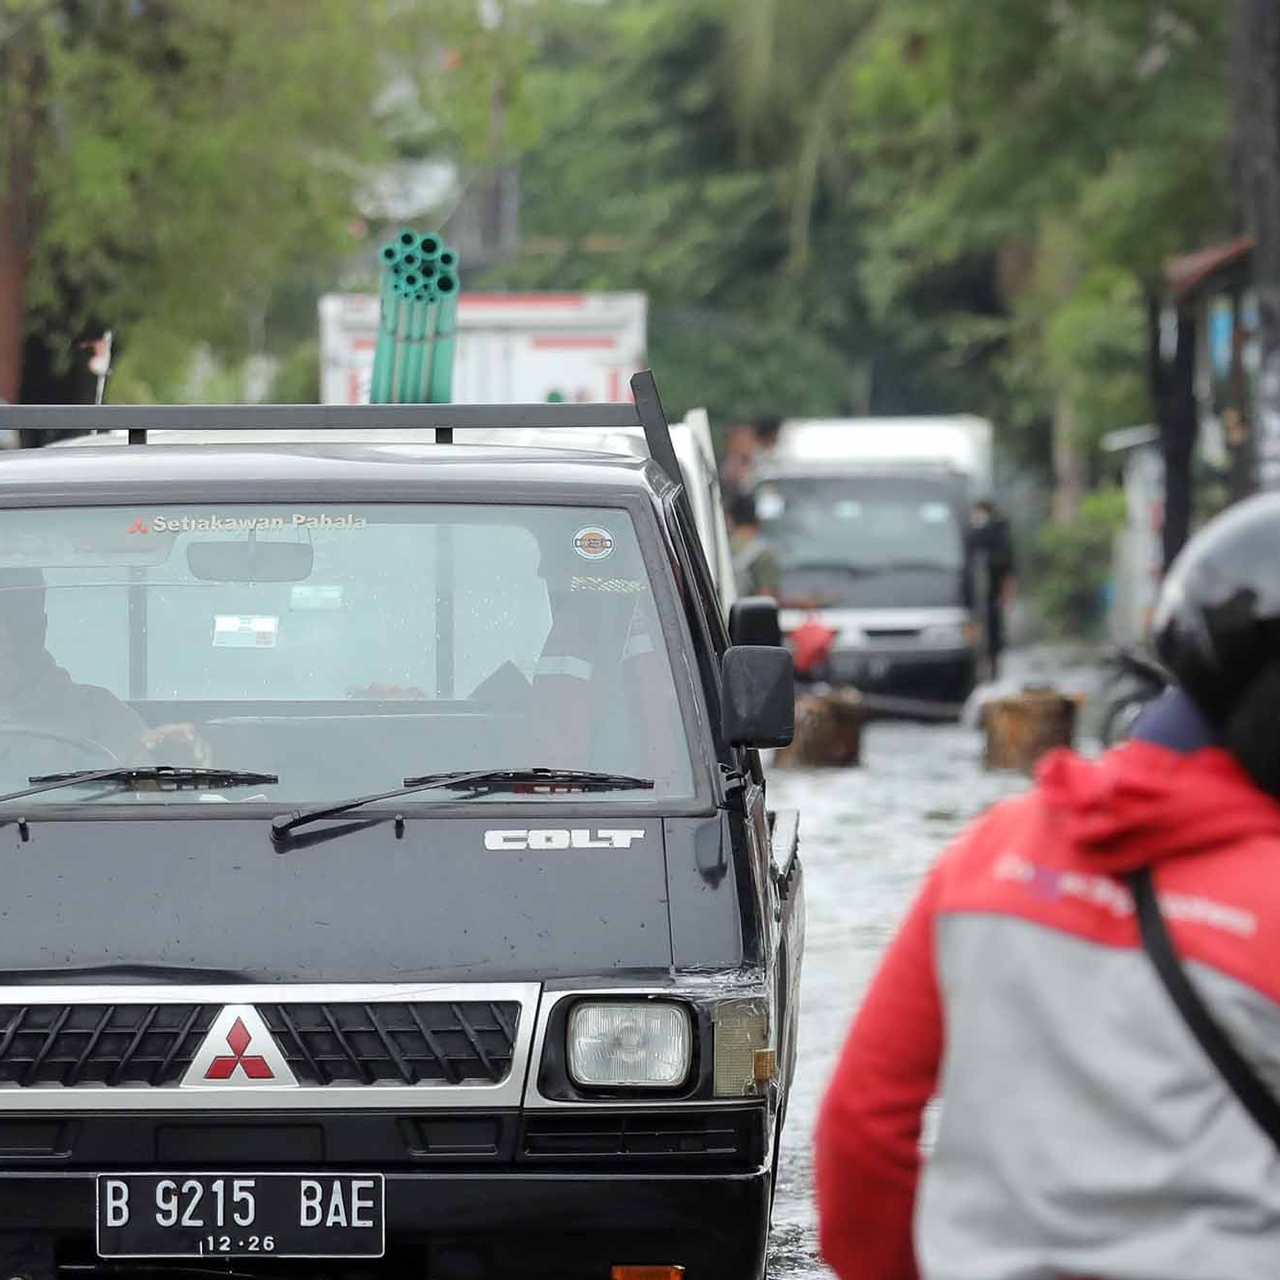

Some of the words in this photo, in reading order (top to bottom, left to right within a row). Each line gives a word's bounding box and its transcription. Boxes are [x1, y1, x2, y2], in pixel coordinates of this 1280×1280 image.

[153, 515, 282, 533] Setiakawan
[484, 829, 646, 850] COLT
[106, 1180, 129, 1227] B
[155, 1180, 255, 1227] 9215
[300, 1180, 374, 1227] BAE
